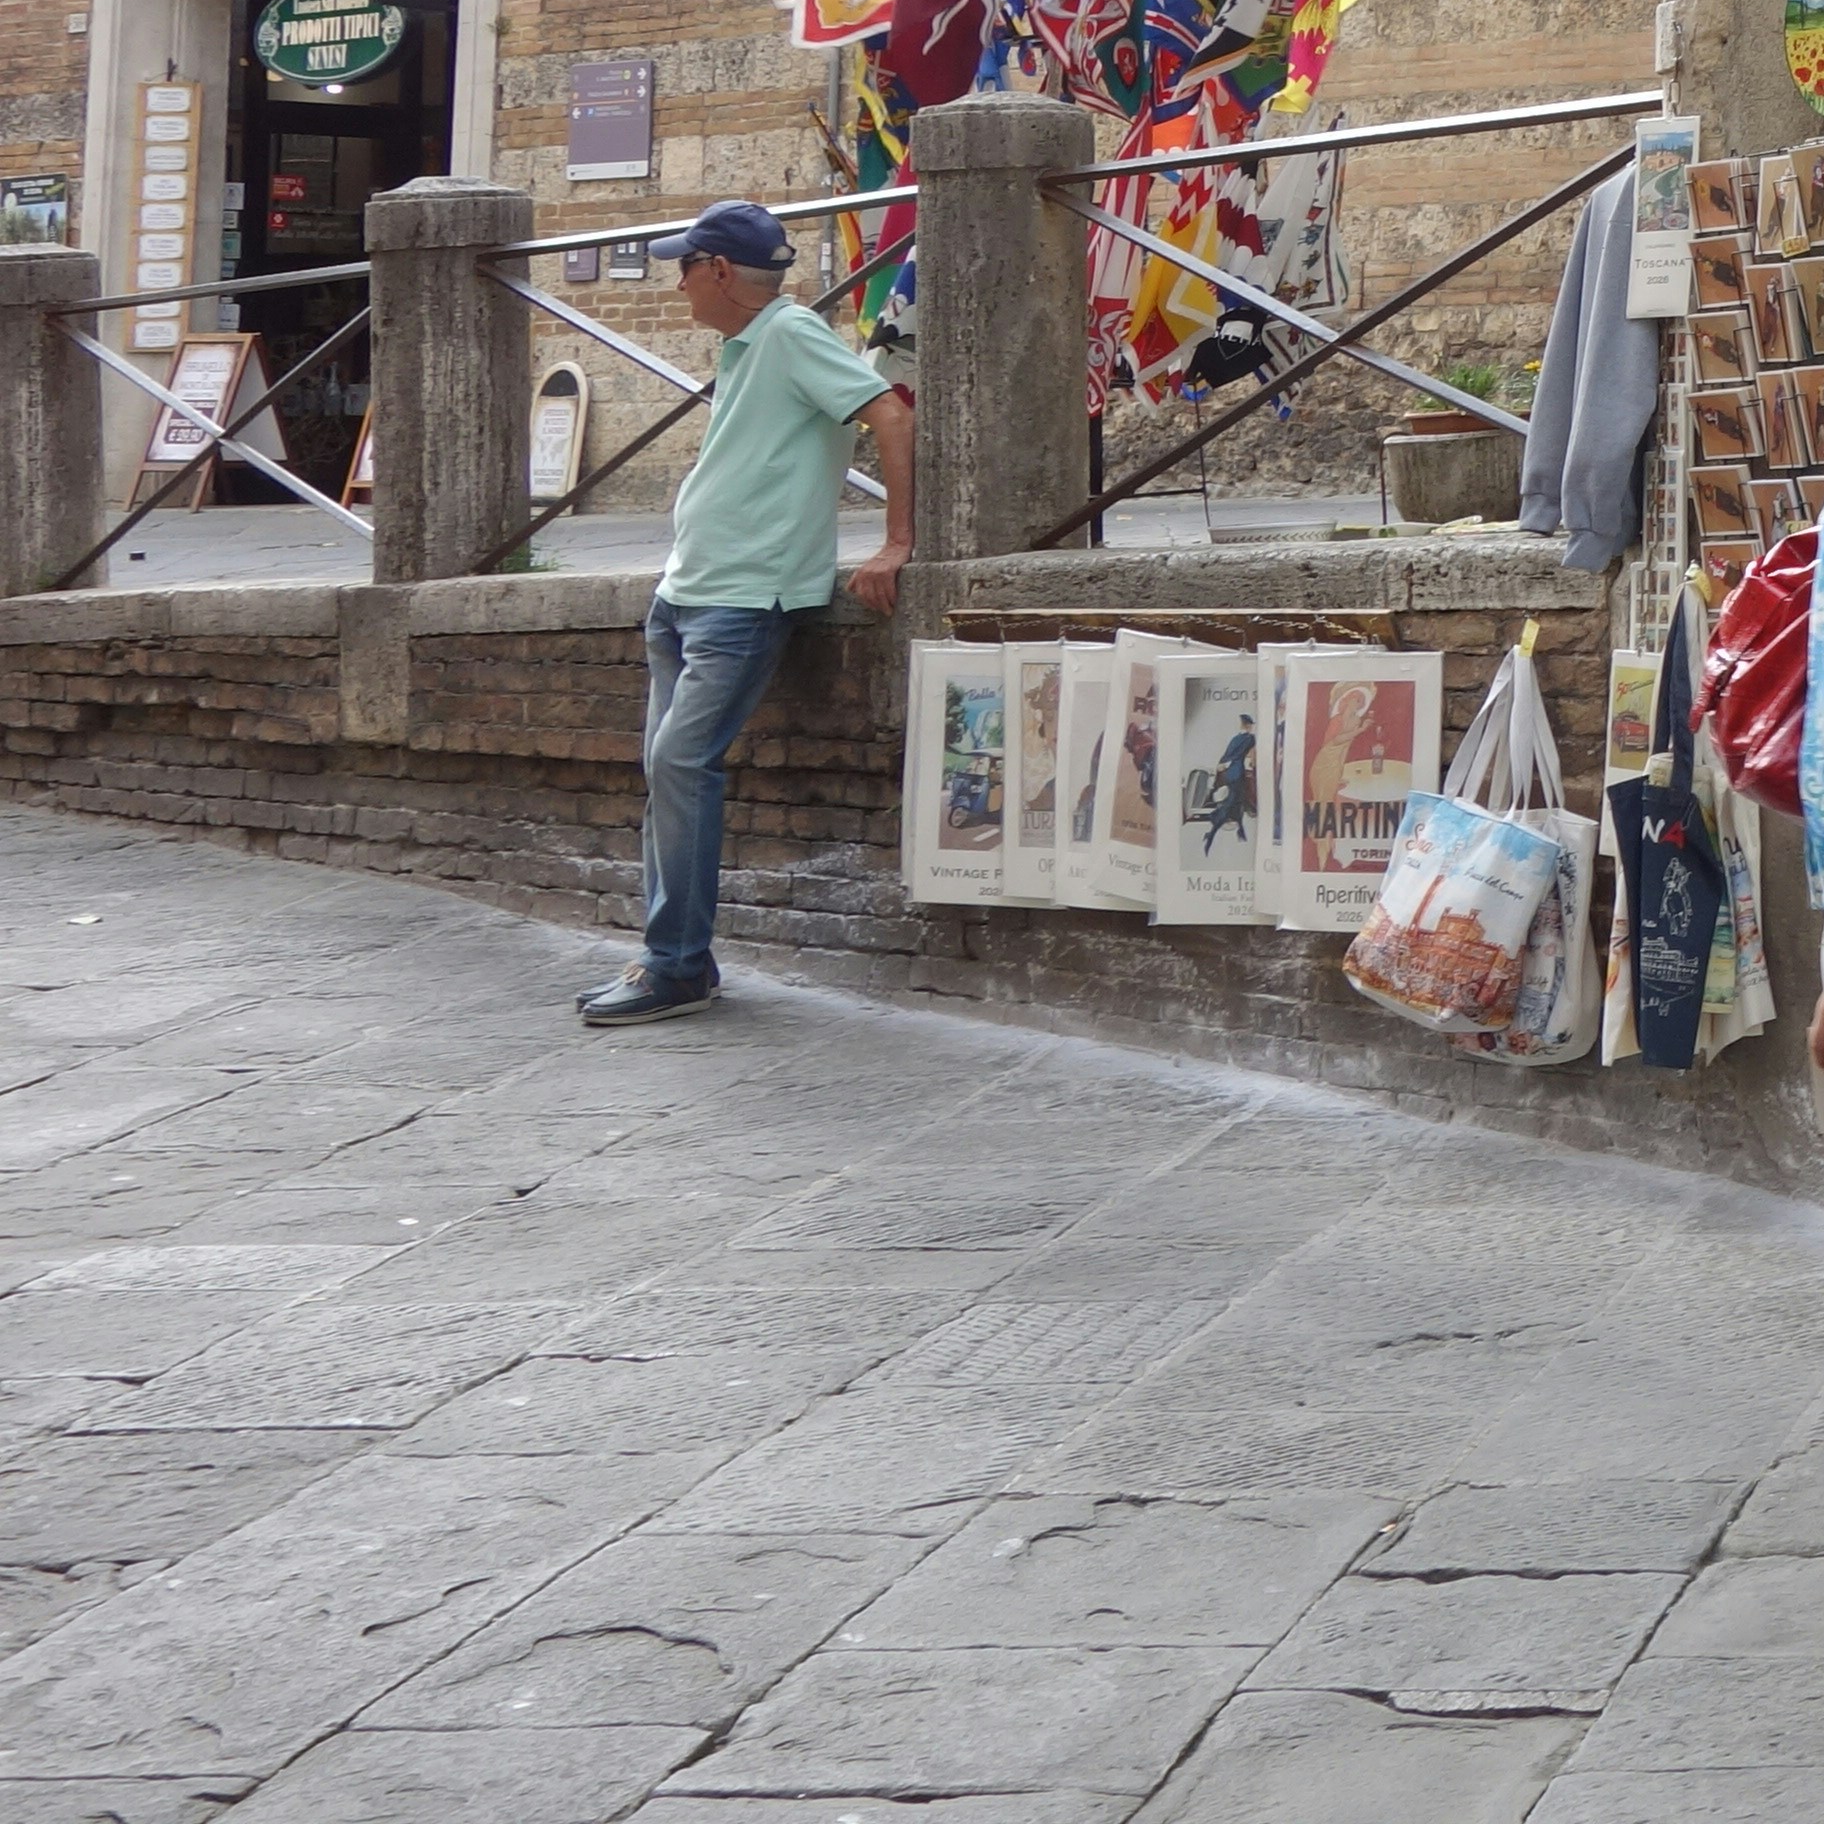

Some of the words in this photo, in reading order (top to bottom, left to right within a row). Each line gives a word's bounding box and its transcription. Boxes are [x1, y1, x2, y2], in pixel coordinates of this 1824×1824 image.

[281, 16, 343, 46] PRODOTTI
[343, 12, 380, 40] TIPICI
[1636, 257, 1686, 269] TOSCANA
[1203, 687, 1248, 701] Italian
[930, 865, 990, 880] VINTAGE
[1186, 877, 1231, 892] Moda
[1336, 911, 1364, 923] 2026
